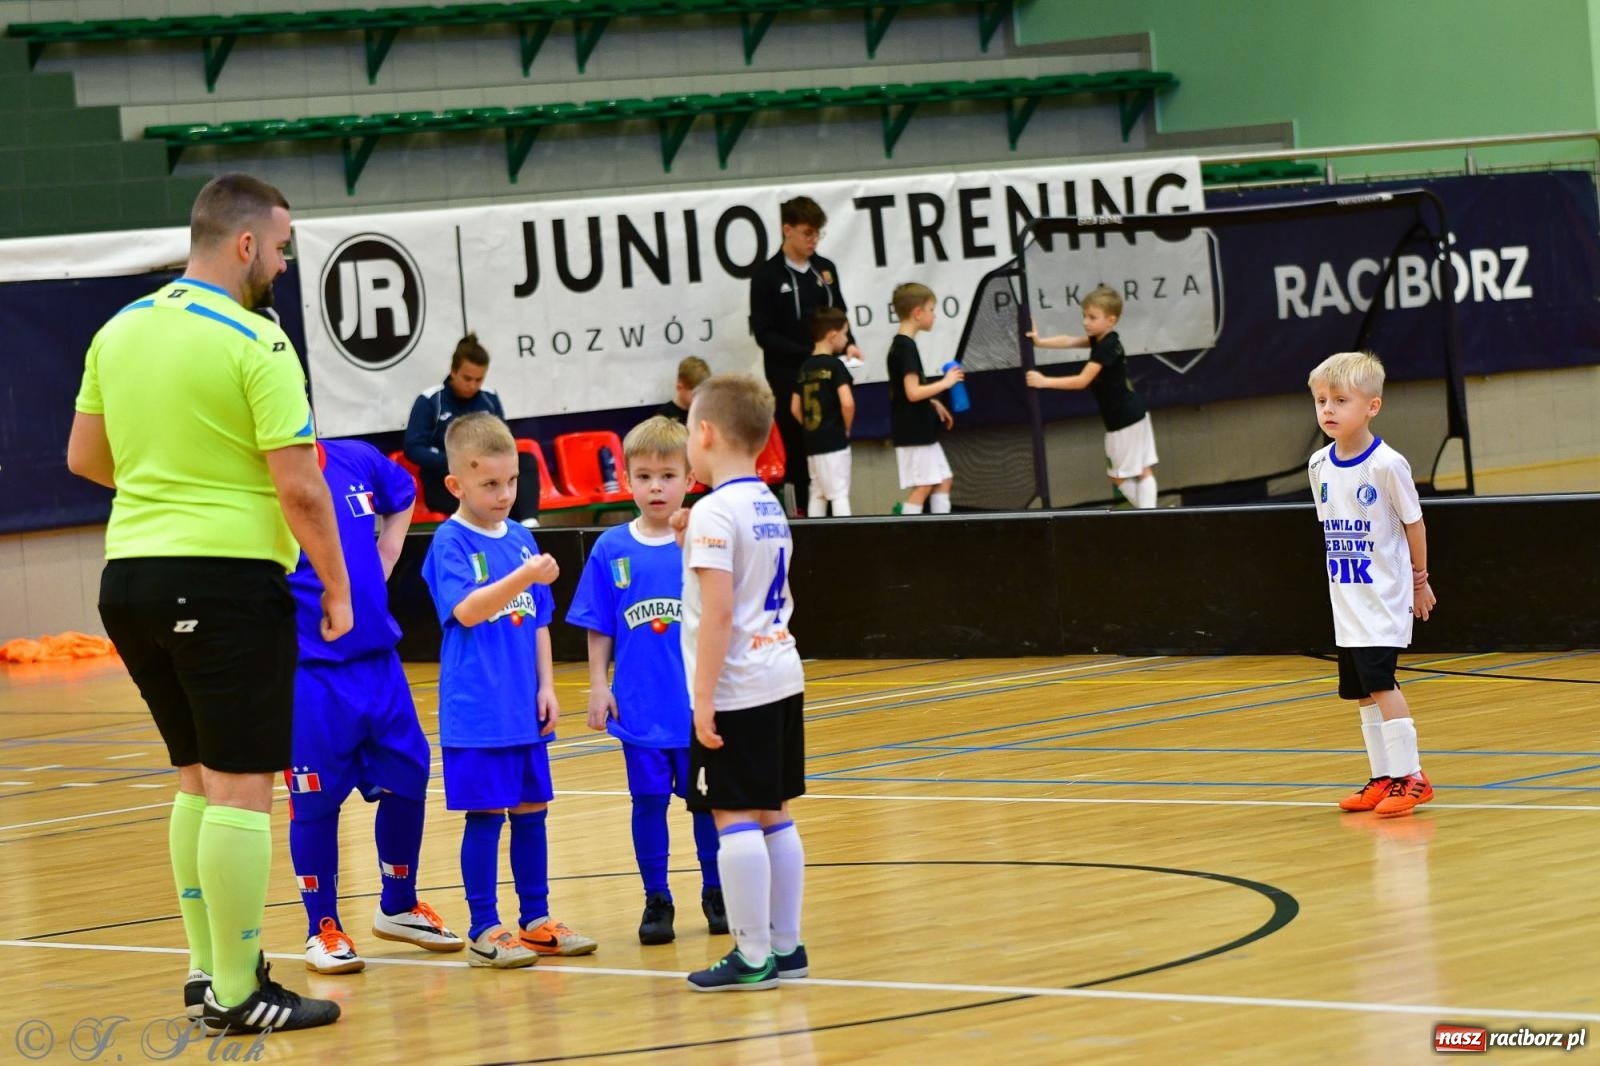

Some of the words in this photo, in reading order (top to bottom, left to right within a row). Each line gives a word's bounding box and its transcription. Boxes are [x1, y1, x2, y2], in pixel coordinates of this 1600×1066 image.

[513, 205, 769, 299] JUNIO
[852, 172, 1191, 269] TRENING
[517, 315, 715, 358] ROZWÓJ
[994, 273, 1200, 313] PŁKRZA
[802, 382, 822, 431] 5
[1324, 519, 1371, 532] AWILON
[1326, 539, 1375, 552] EBLOWY
[763, 547, 786, 624] 4
[1328, 558, 1374, 584] PIK
[627, 602, 683, 623] TYMBAR
[696, 766, 709, 796] 4
